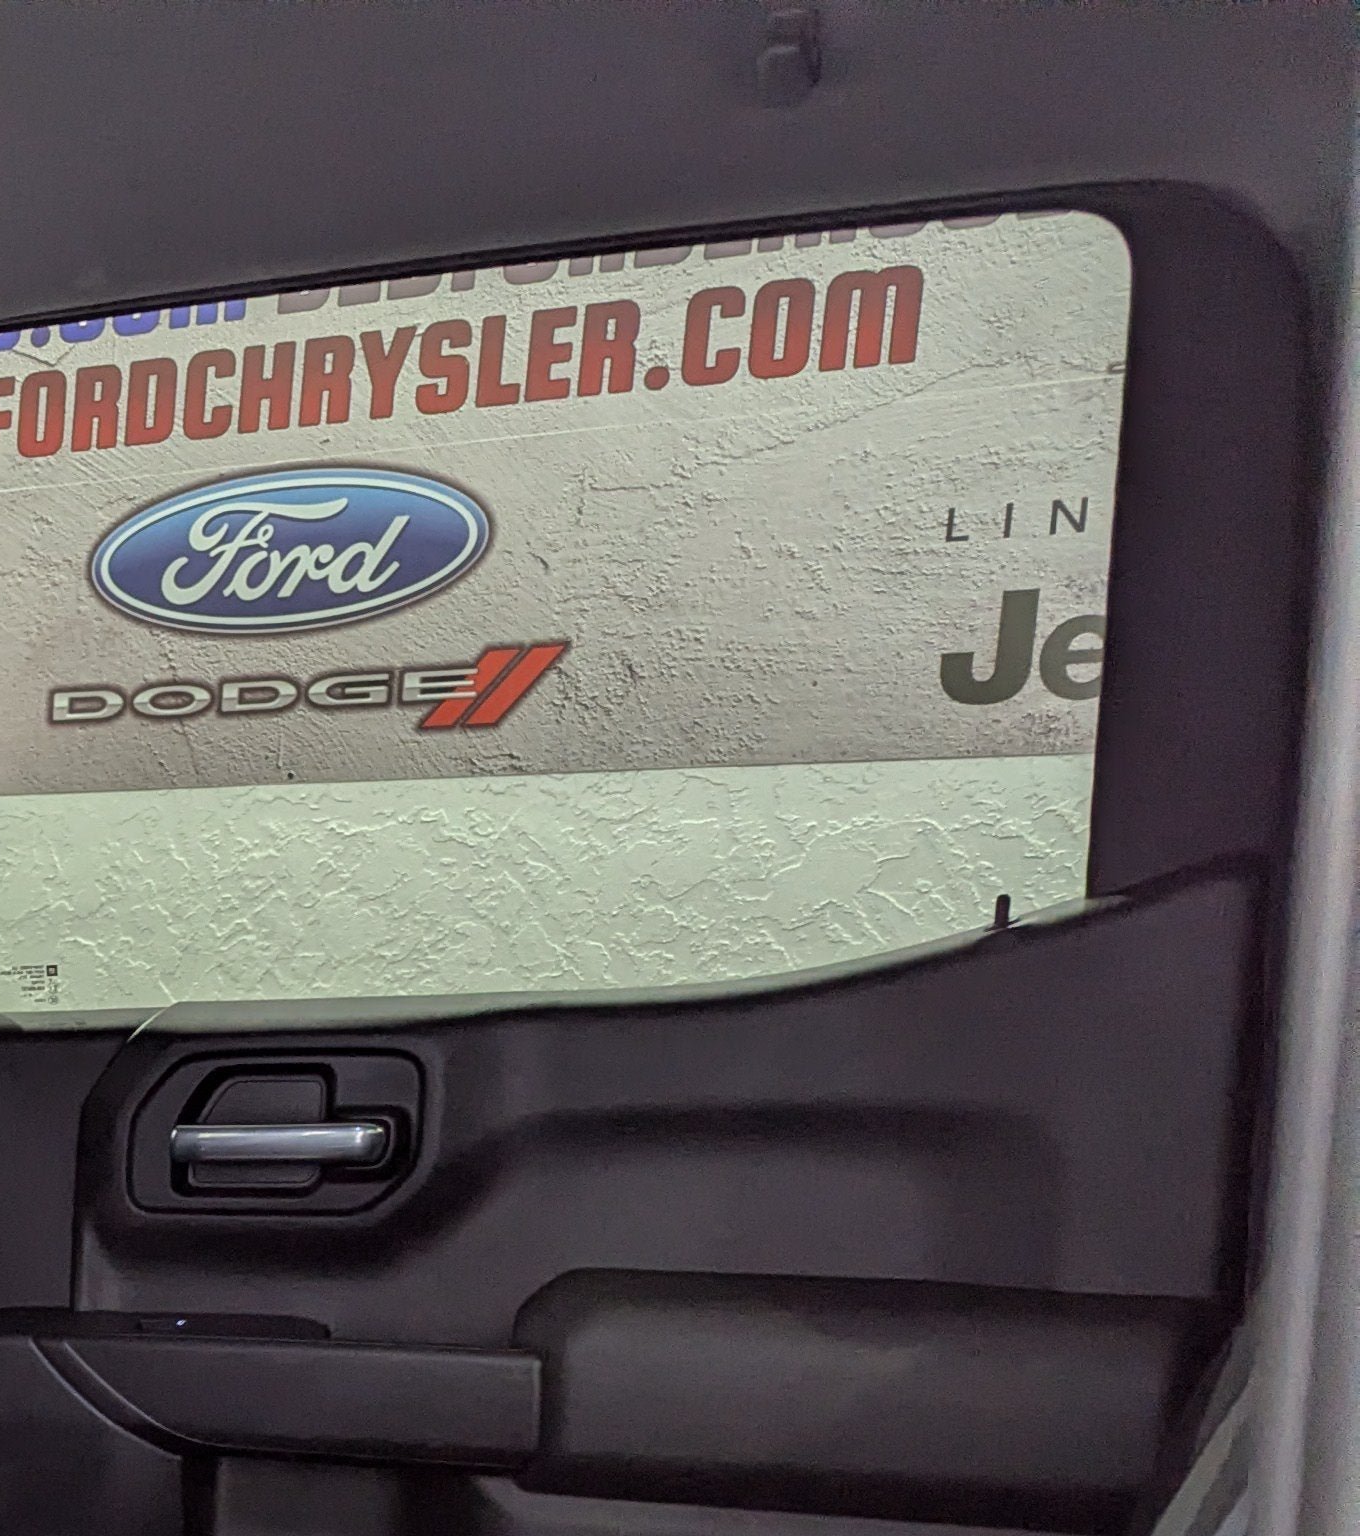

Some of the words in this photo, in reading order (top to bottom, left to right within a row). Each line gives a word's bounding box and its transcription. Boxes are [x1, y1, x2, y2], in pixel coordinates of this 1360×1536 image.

[160, 496, 411, 605] Ford
[945, 496, 1089, 543] LIN
[939, 588, 1108, 705] Je
[51, 667, 479, 722] DODGE
